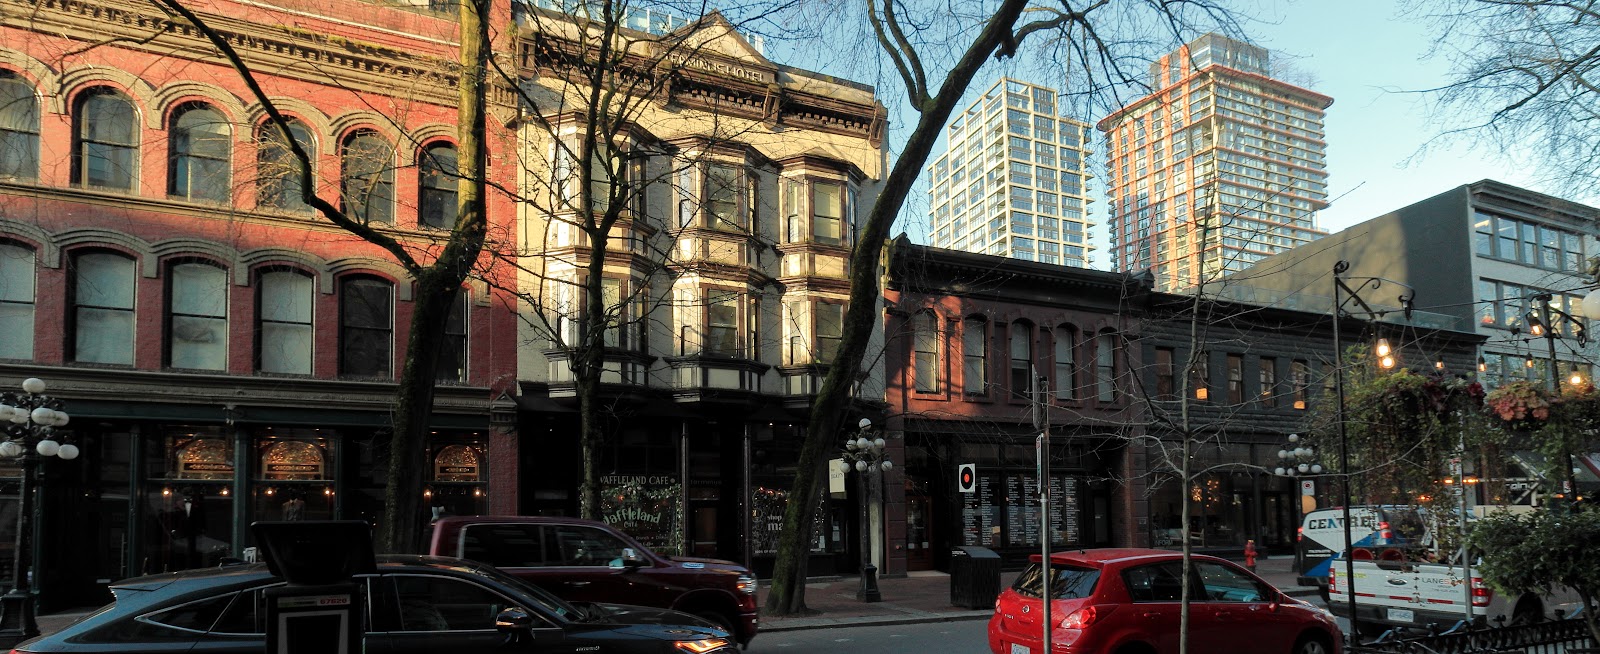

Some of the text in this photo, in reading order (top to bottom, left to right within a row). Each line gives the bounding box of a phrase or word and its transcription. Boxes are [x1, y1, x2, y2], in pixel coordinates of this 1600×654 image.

[726, 65, 764, 82] HOTEL
[766, 513, 783, 522] shop
[1308, 515, 1376, 530] CENTRE
